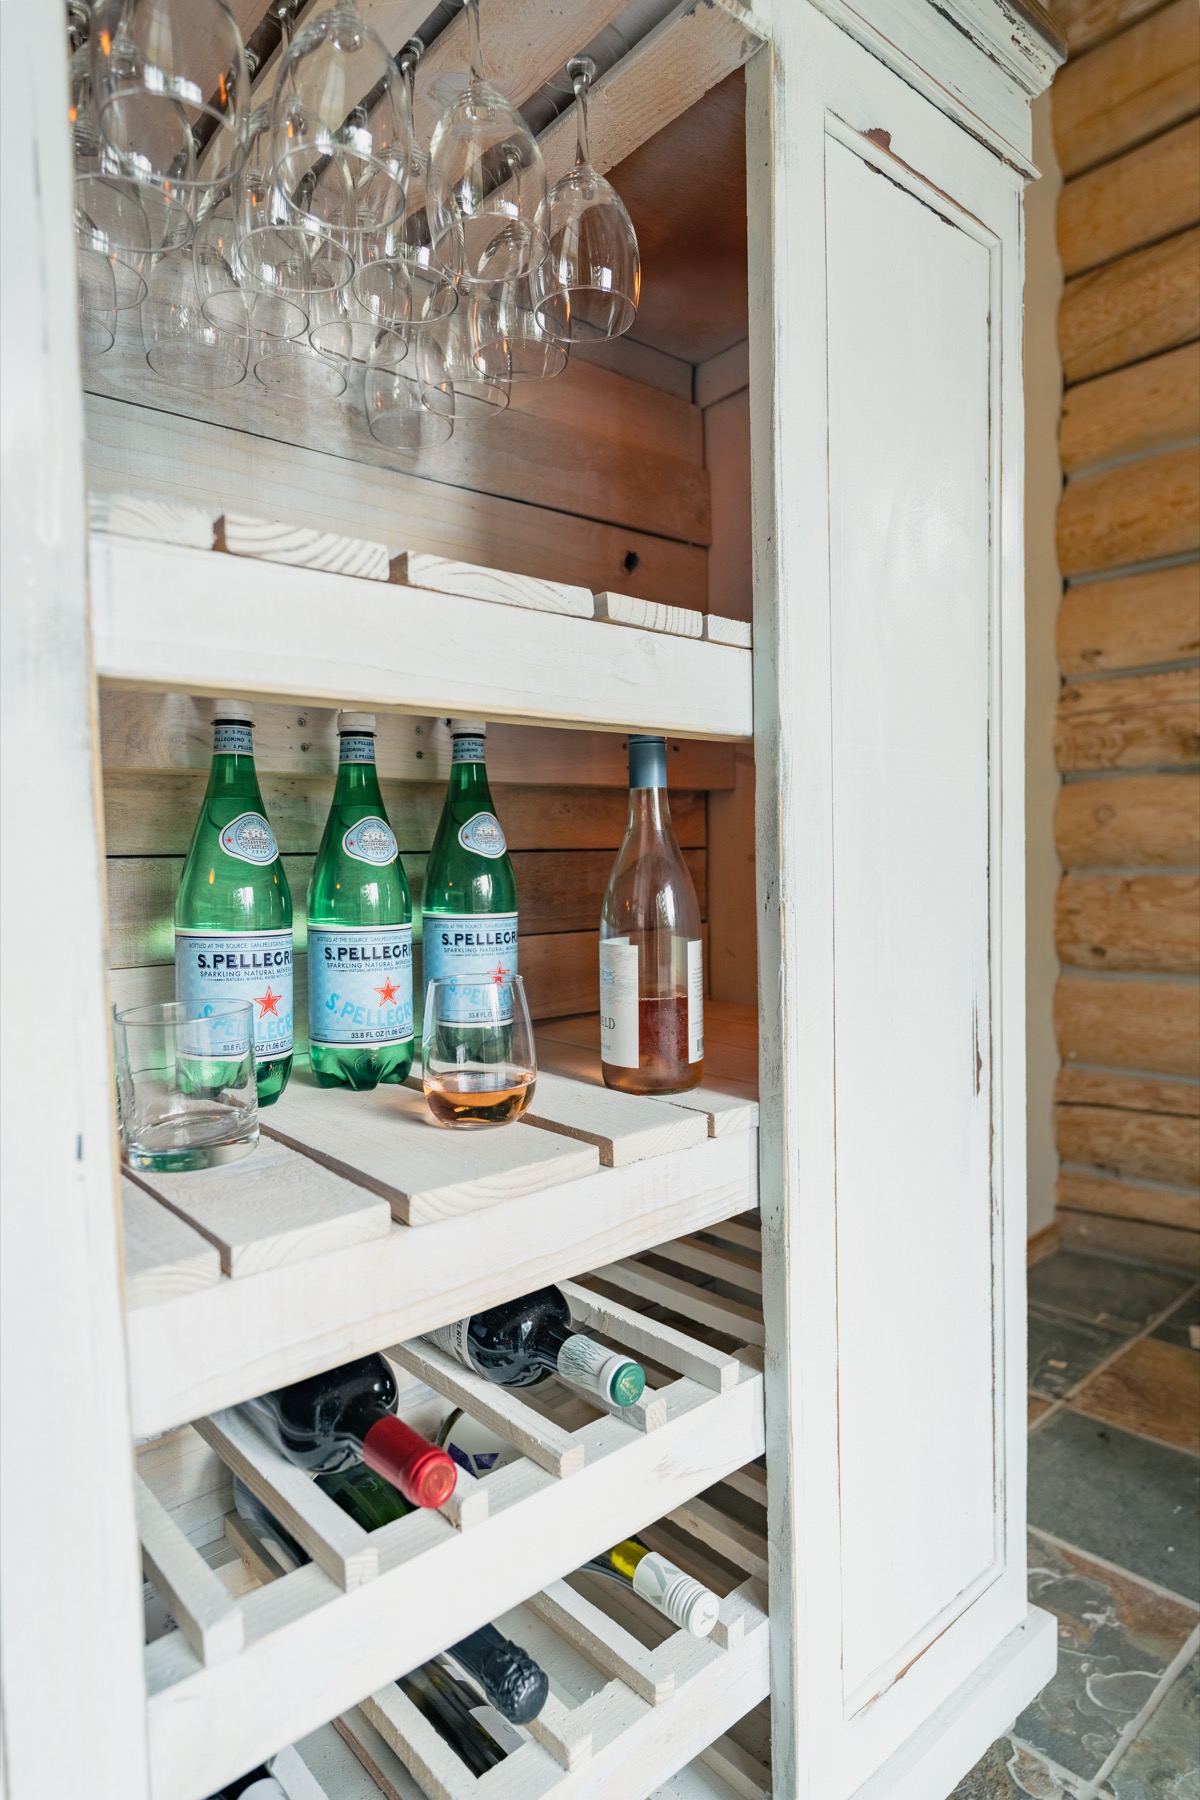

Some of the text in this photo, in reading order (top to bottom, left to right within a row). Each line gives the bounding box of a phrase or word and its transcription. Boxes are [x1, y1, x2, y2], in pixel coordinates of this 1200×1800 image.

[441, 930, 518, 947] S.PELLEGR
[324, 943, 412, 961] S.PELLEGRI
[200, 970, 241, 978] SPARKLING
[244, 968, 275, 977] NATURAL
[375, 1030, 385, 1038] OZ
[222, 1044, 235, 1052] 33.8
